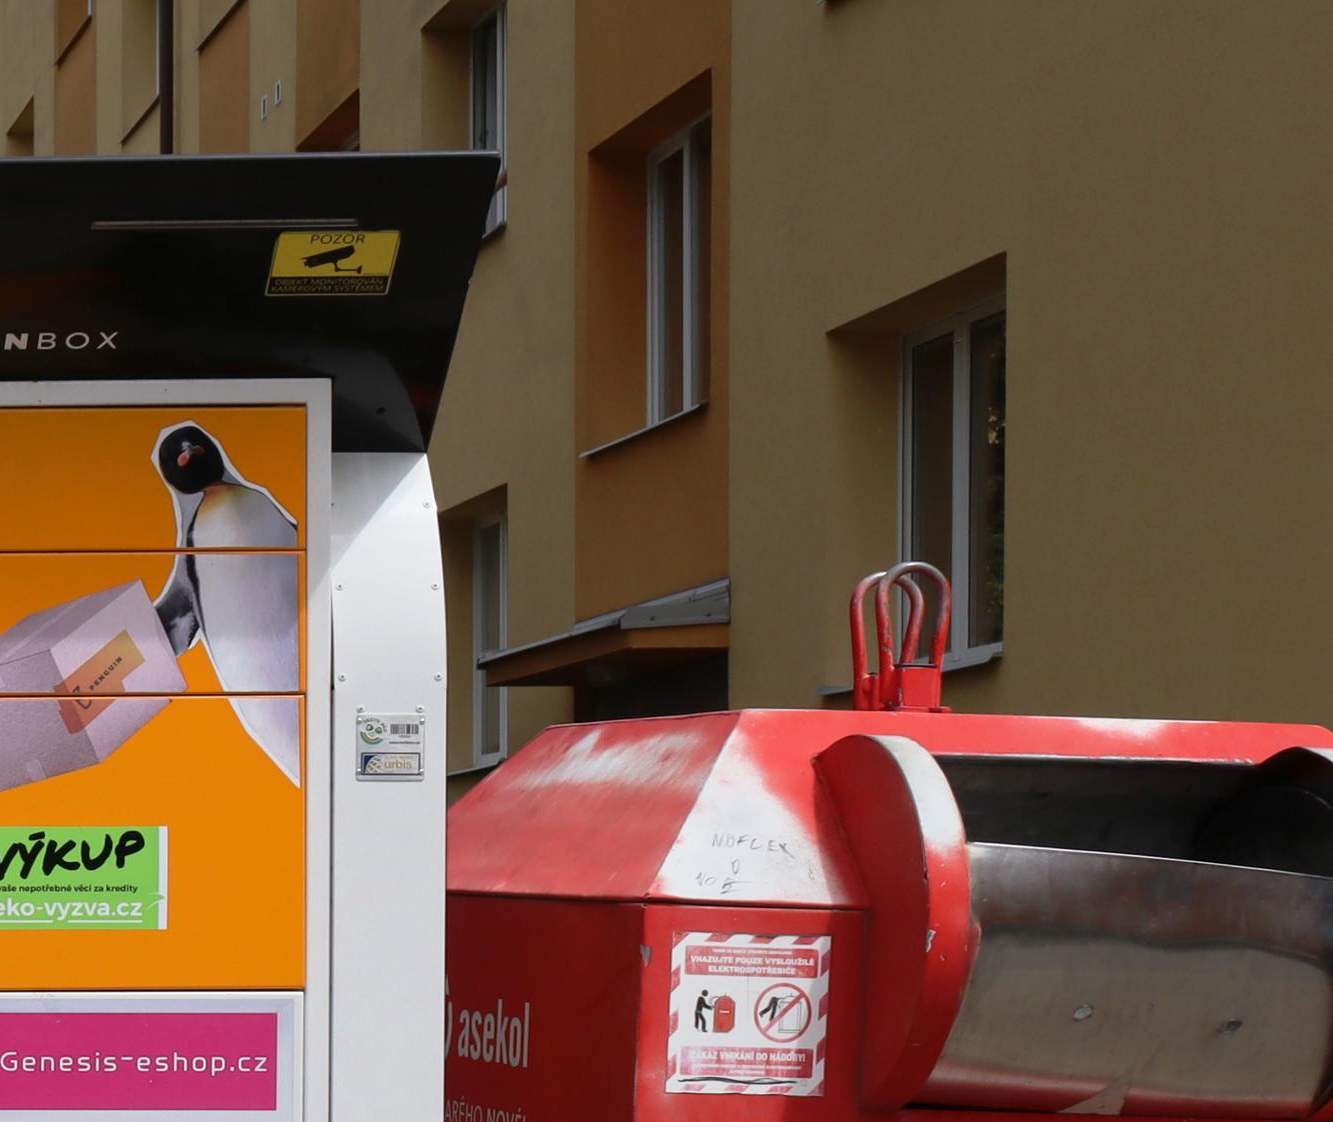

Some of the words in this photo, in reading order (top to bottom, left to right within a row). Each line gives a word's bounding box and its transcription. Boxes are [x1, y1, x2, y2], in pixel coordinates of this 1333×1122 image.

[309, 233, 366, 244] POZOR
[457, 999, 530, 1068] asekol
[0, 1051, 268, 1077] Genesis-eshop.cz
